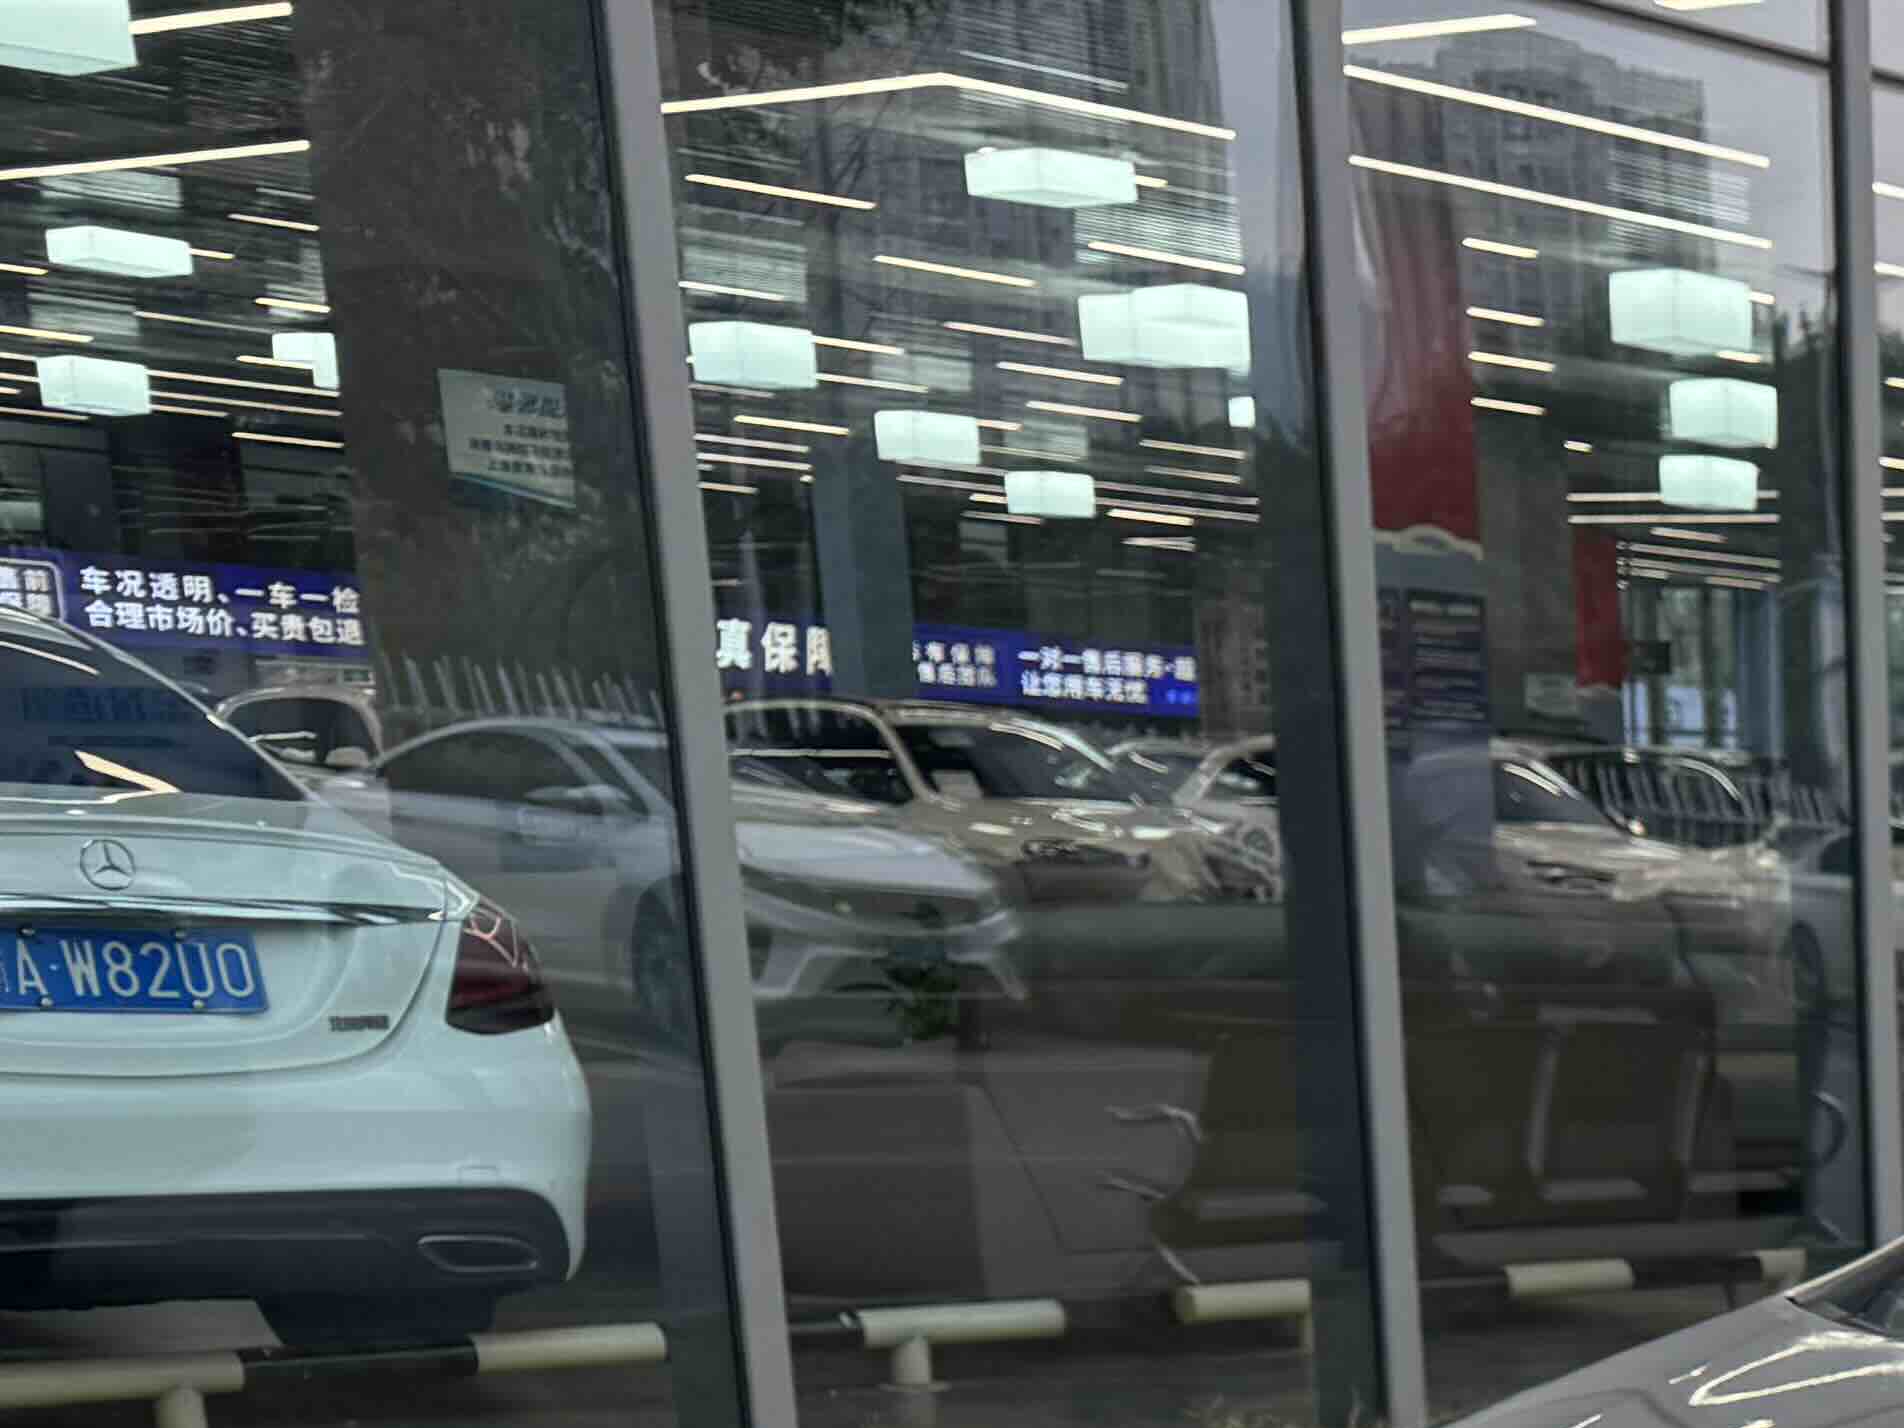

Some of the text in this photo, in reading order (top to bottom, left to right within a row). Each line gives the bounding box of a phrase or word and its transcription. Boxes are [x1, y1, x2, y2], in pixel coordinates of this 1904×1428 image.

[79, 566, 361, 616] 车况透明、一车一检
[84, 600, 366, 646] 合理市场价、买贵包退
